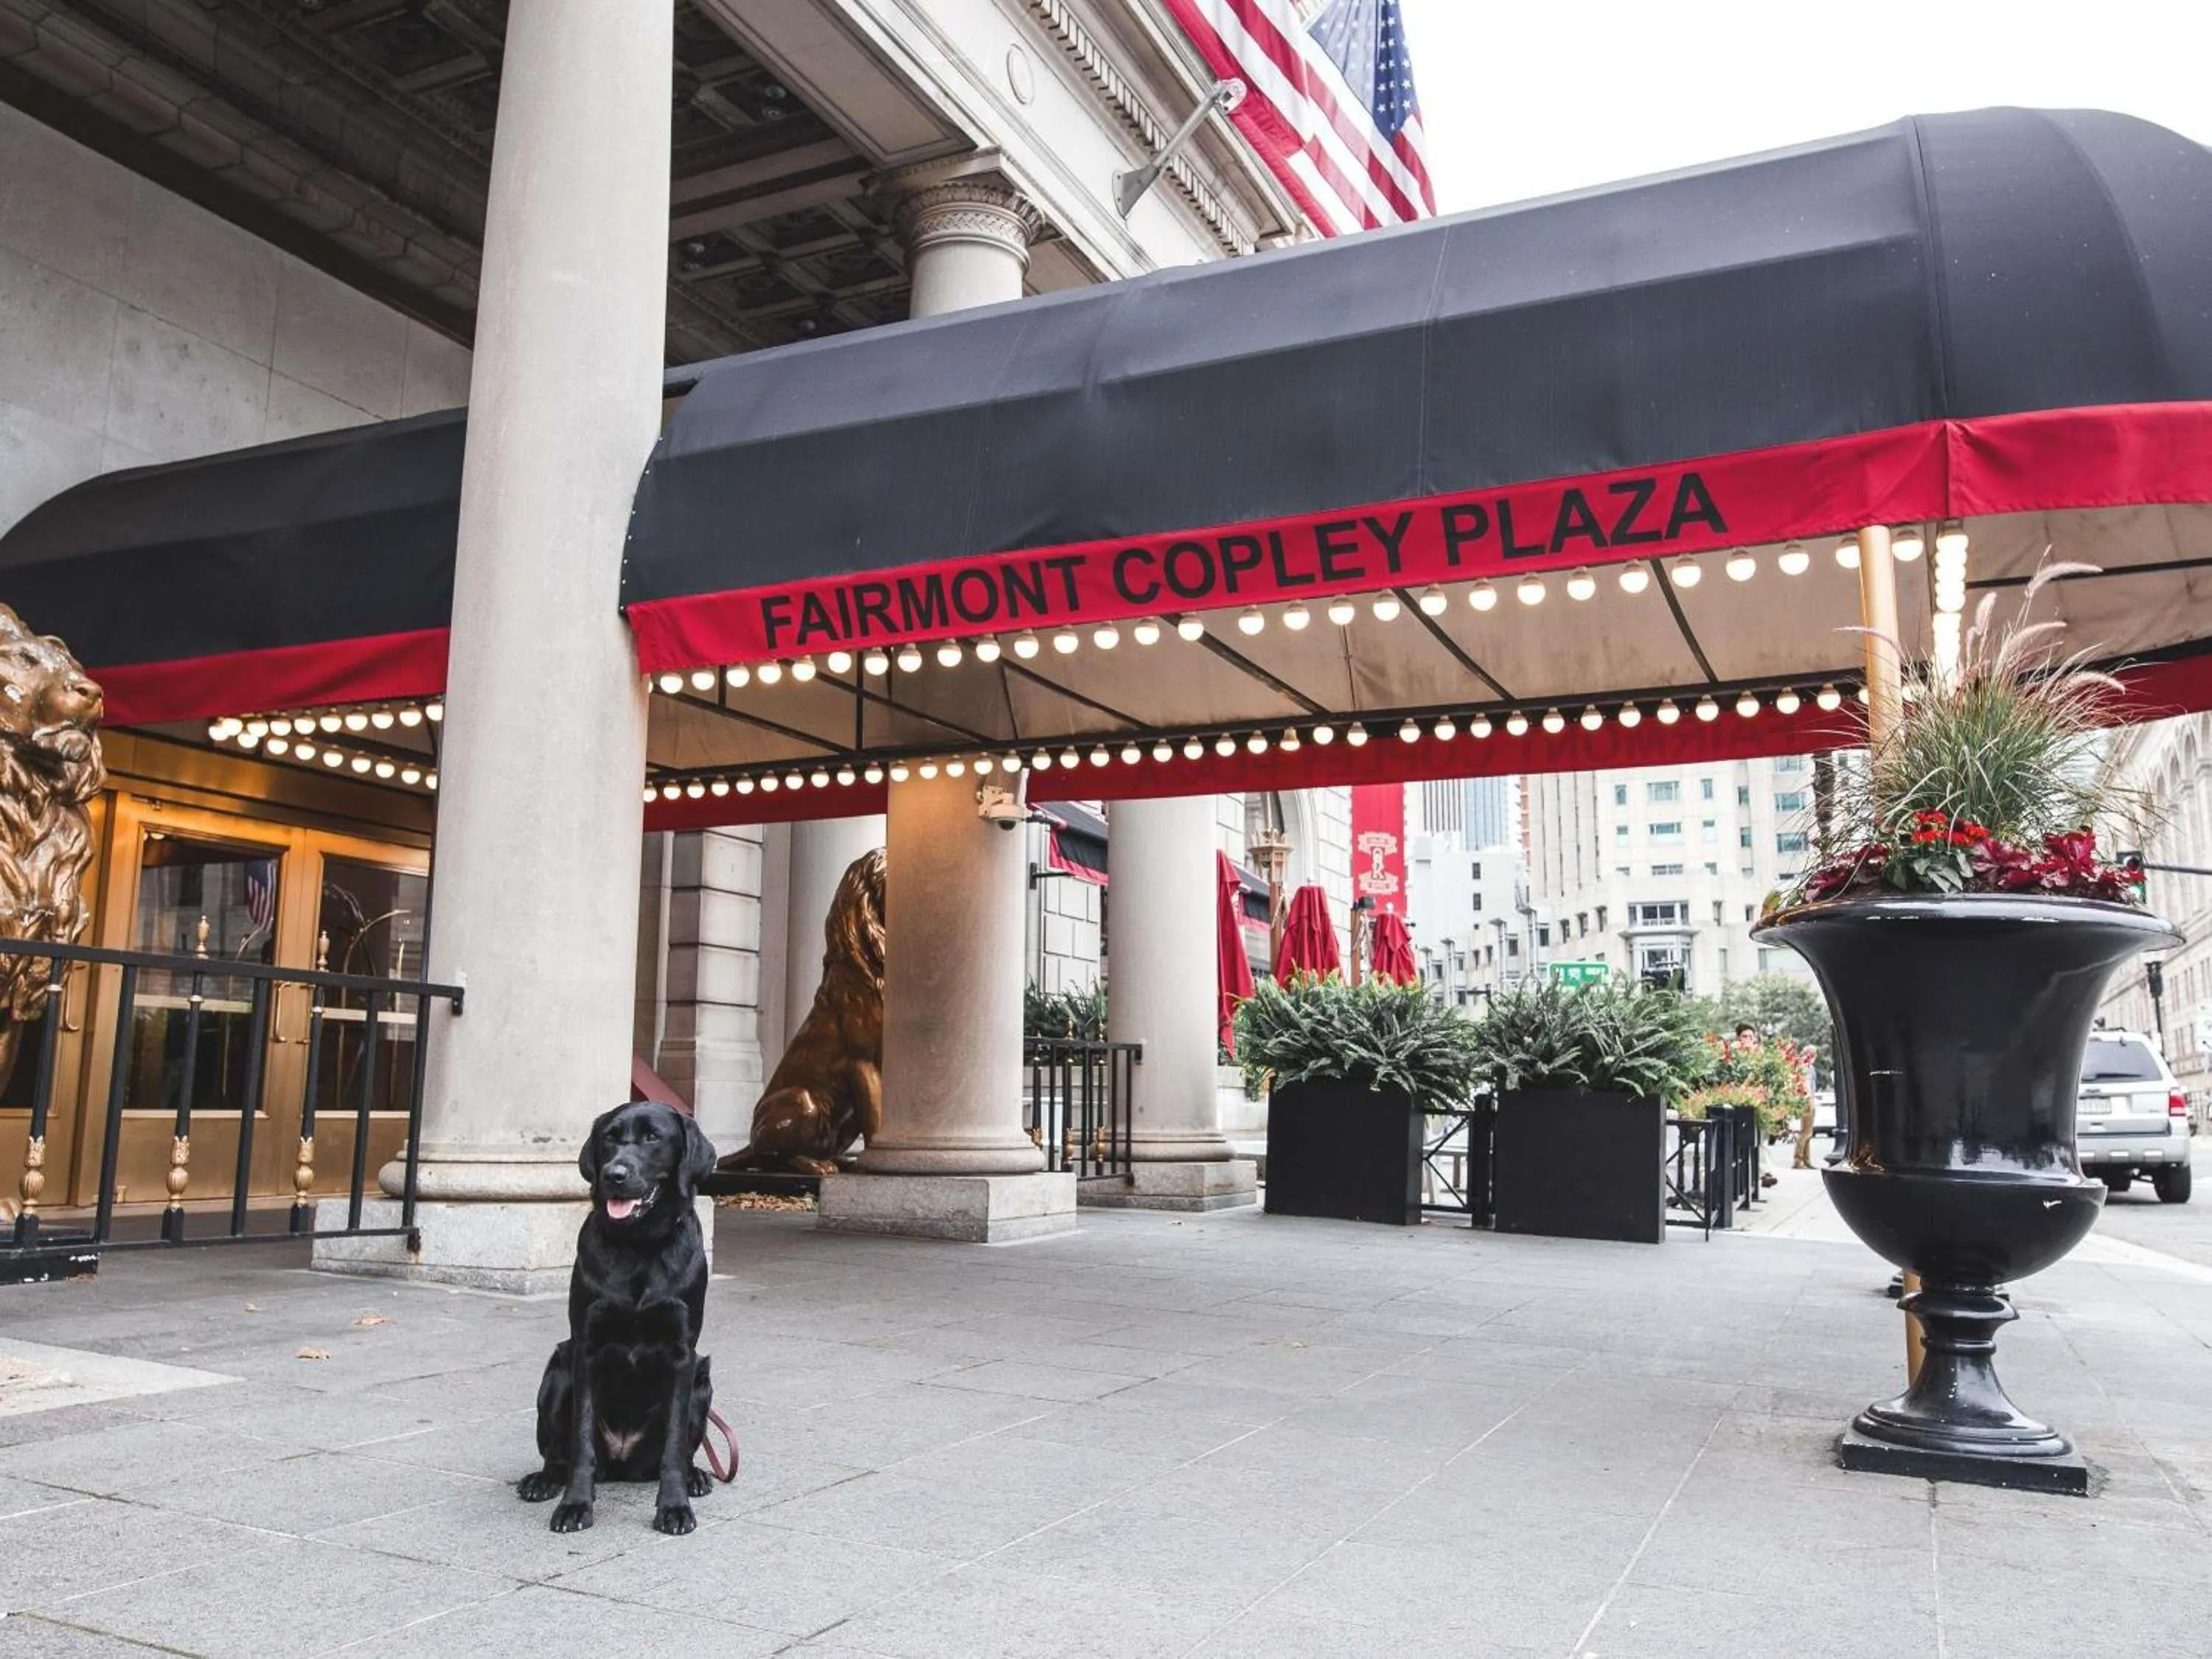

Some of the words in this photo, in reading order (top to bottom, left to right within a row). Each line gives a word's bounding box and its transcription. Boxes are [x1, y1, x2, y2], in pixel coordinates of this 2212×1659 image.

[760, 555, 1085, 650] FAIRMONT
[1113, 511, 1414, 605] COPLEY
[1441, 472, 1729, 566] PLAZA
